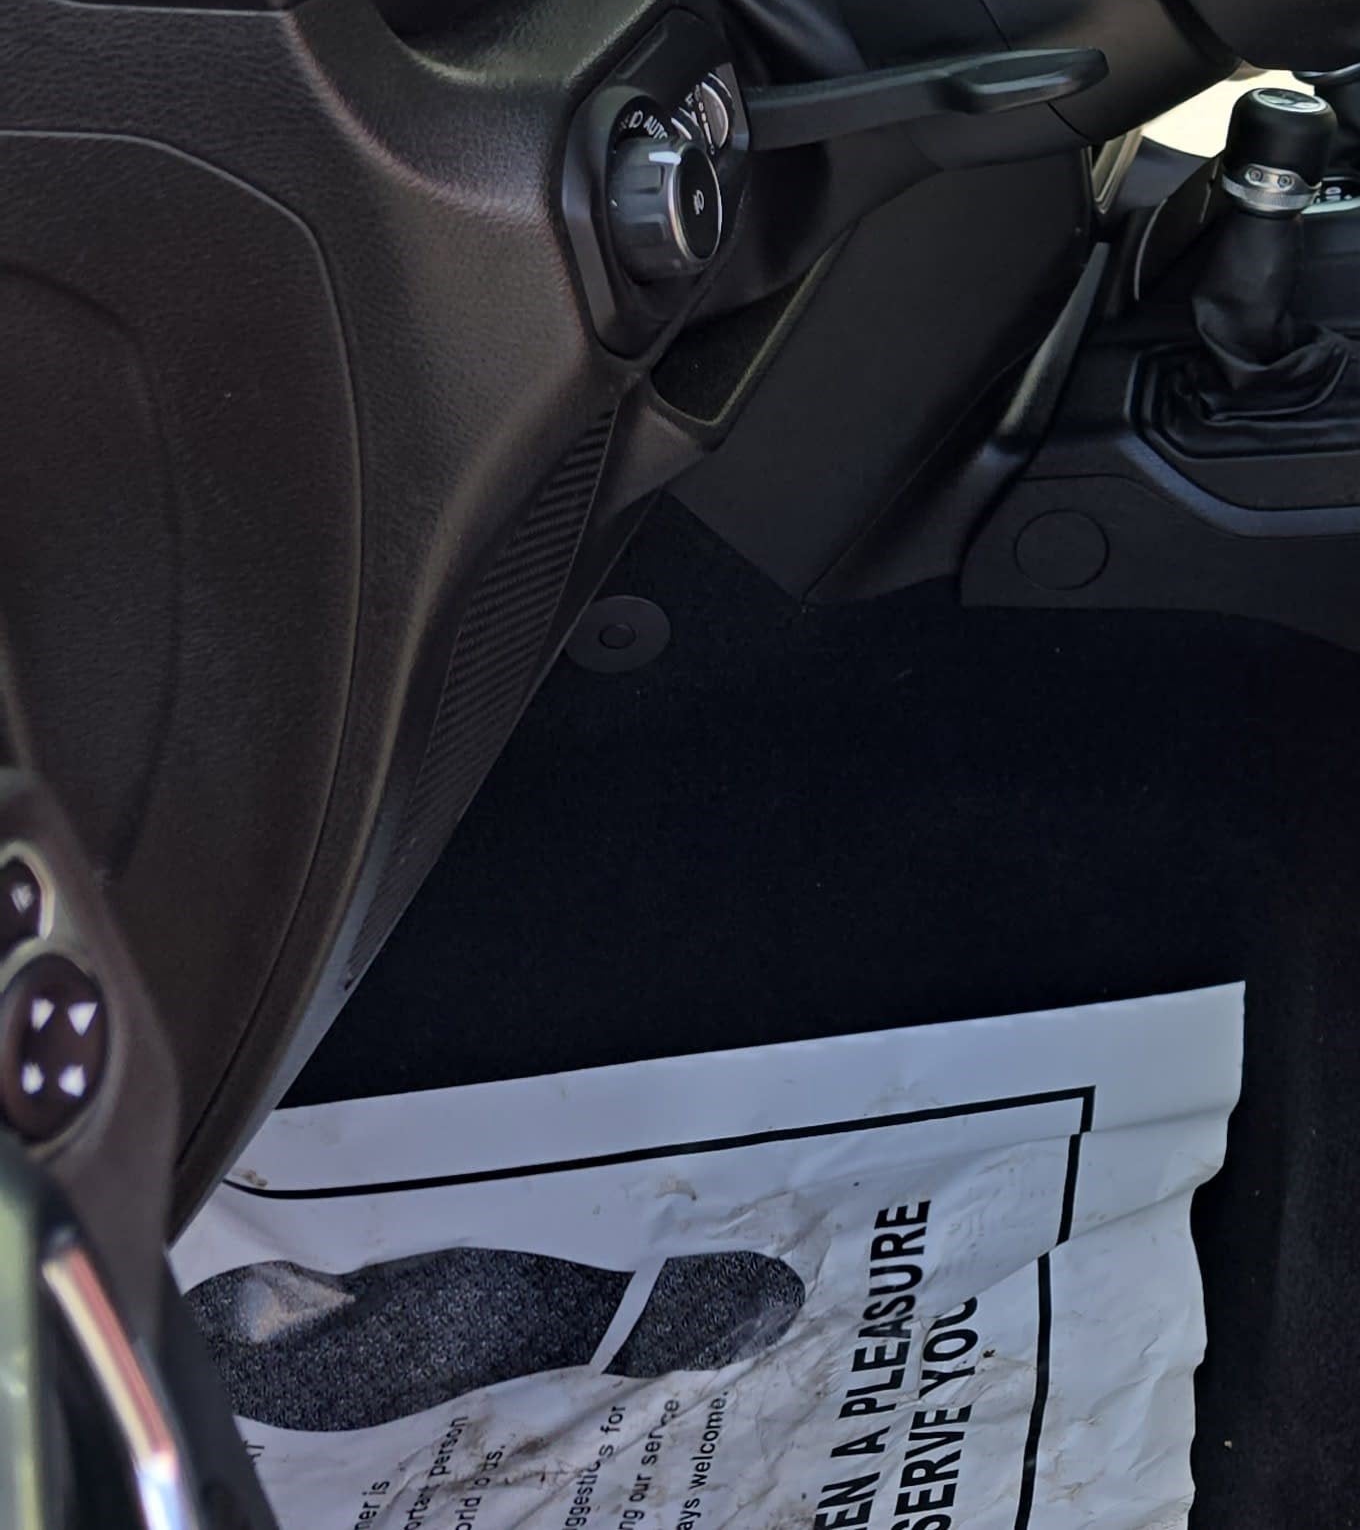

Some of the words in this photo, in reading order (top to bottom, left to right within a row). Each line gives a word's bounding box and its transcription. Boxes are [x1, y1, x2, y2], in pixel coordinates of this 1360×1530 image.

[838, 1199, 932, 1420] PLEASURE
[919, 1296, 979, 1399] YOU
[600, 1405, 626, 1434] for
[690, 1390, 730, 1492] welcome.
[829, 1425, 892, 1459] A
[430, 1416, 468, 1478] person
[363, 1480, 390, 1496] is
[629, 1473, 652, 1503] our
